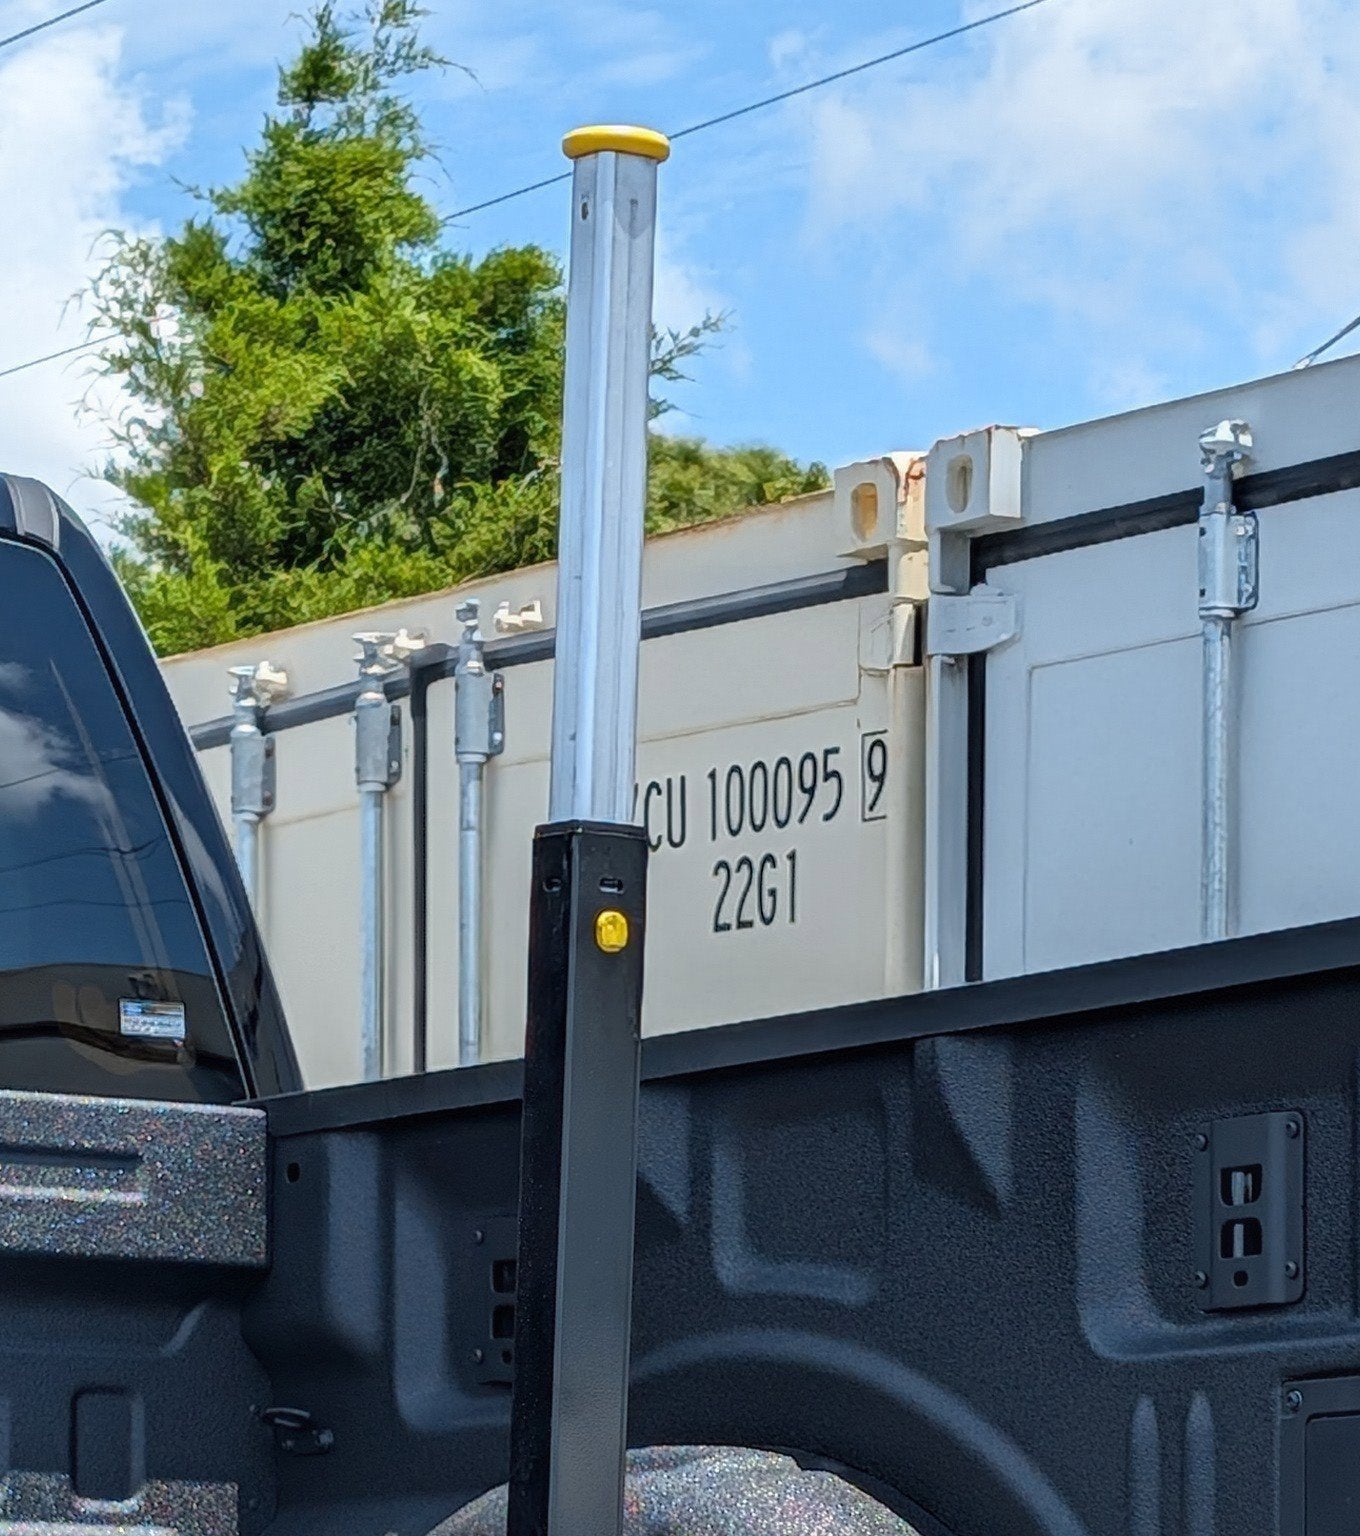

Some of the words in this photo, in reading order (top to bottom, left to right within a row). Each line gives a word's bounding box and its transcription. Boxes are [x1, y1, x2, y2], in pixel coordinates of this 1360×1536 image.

[632, 774, 687, 853] CU
[707, 746, 844, 842] 100095
[867, 738, 888, 813] 9
[713, 849, 797, 934] 22G1
